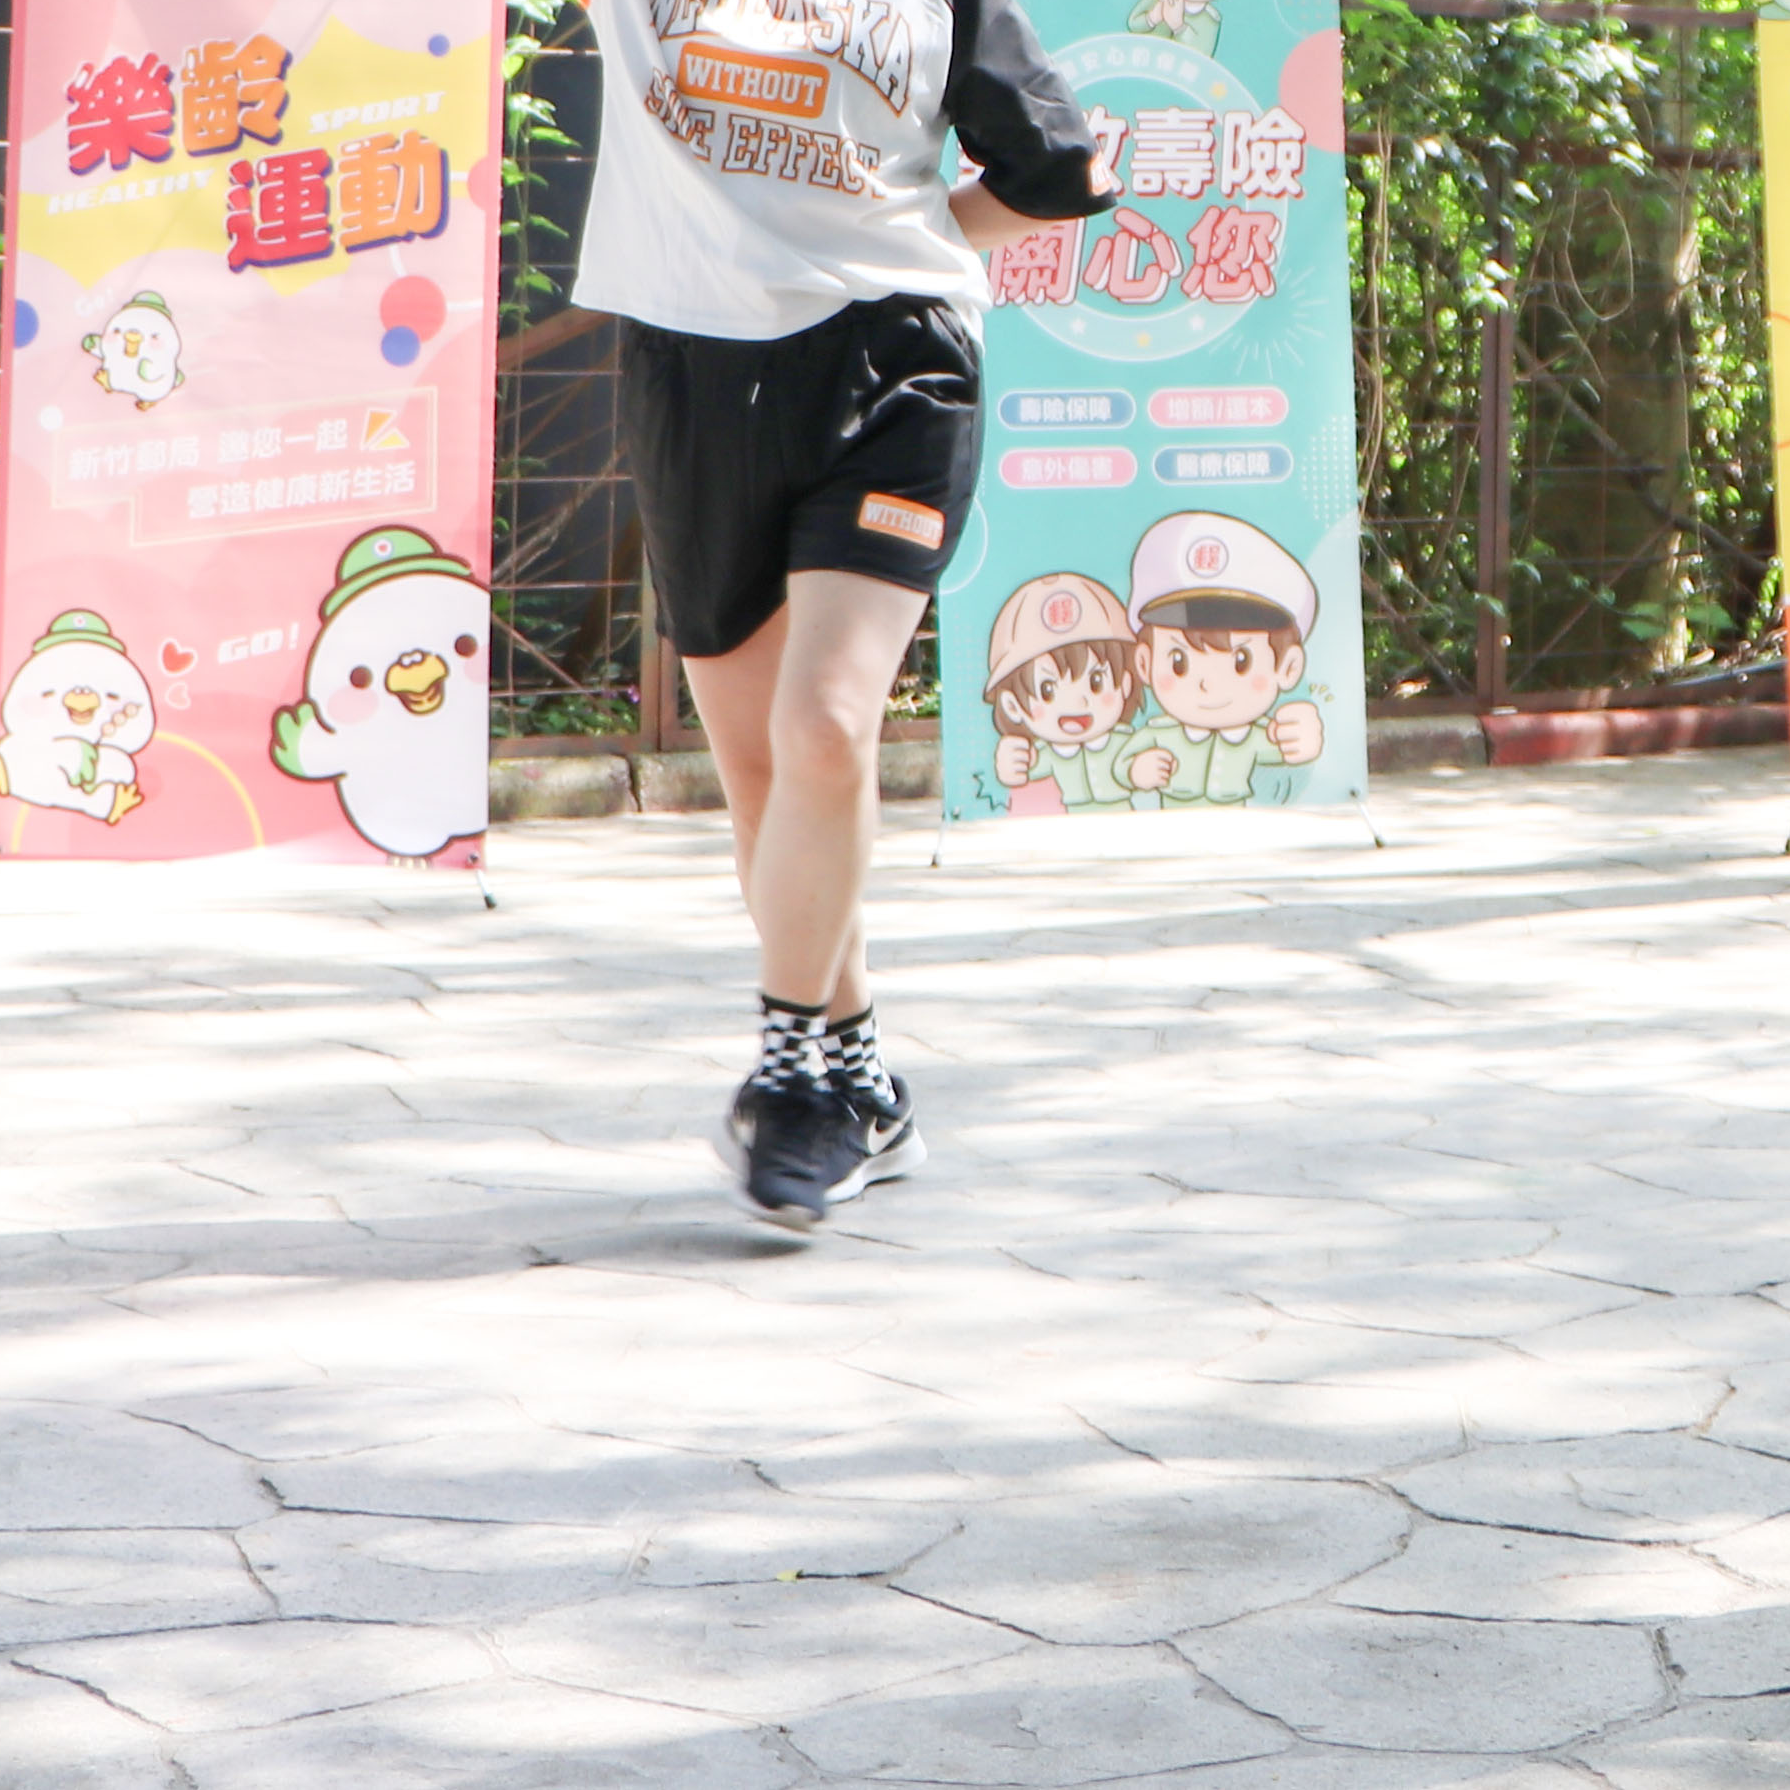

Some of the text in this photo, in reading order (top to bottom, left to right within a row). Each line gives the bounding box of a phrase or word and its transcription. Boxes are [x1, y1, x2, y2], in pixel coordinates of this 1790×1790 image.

[65, 32, 294, 178] 樂齡
[684, 53, 823, 108] WITHOUT
[308, 90, 446, 134] SPORT
[721, 112, 889, 199] EFFECT
[47, 167, 215, 216] HEALTHY
[226, 129, 449, 273] 運動
[67, 435, 202, 481] 新竹郵局
[186, 461, 417, 520] 營造健康新生活
[863, 501, 944, 542] WITHOUT
[217, 622, 301, 665] GO!
